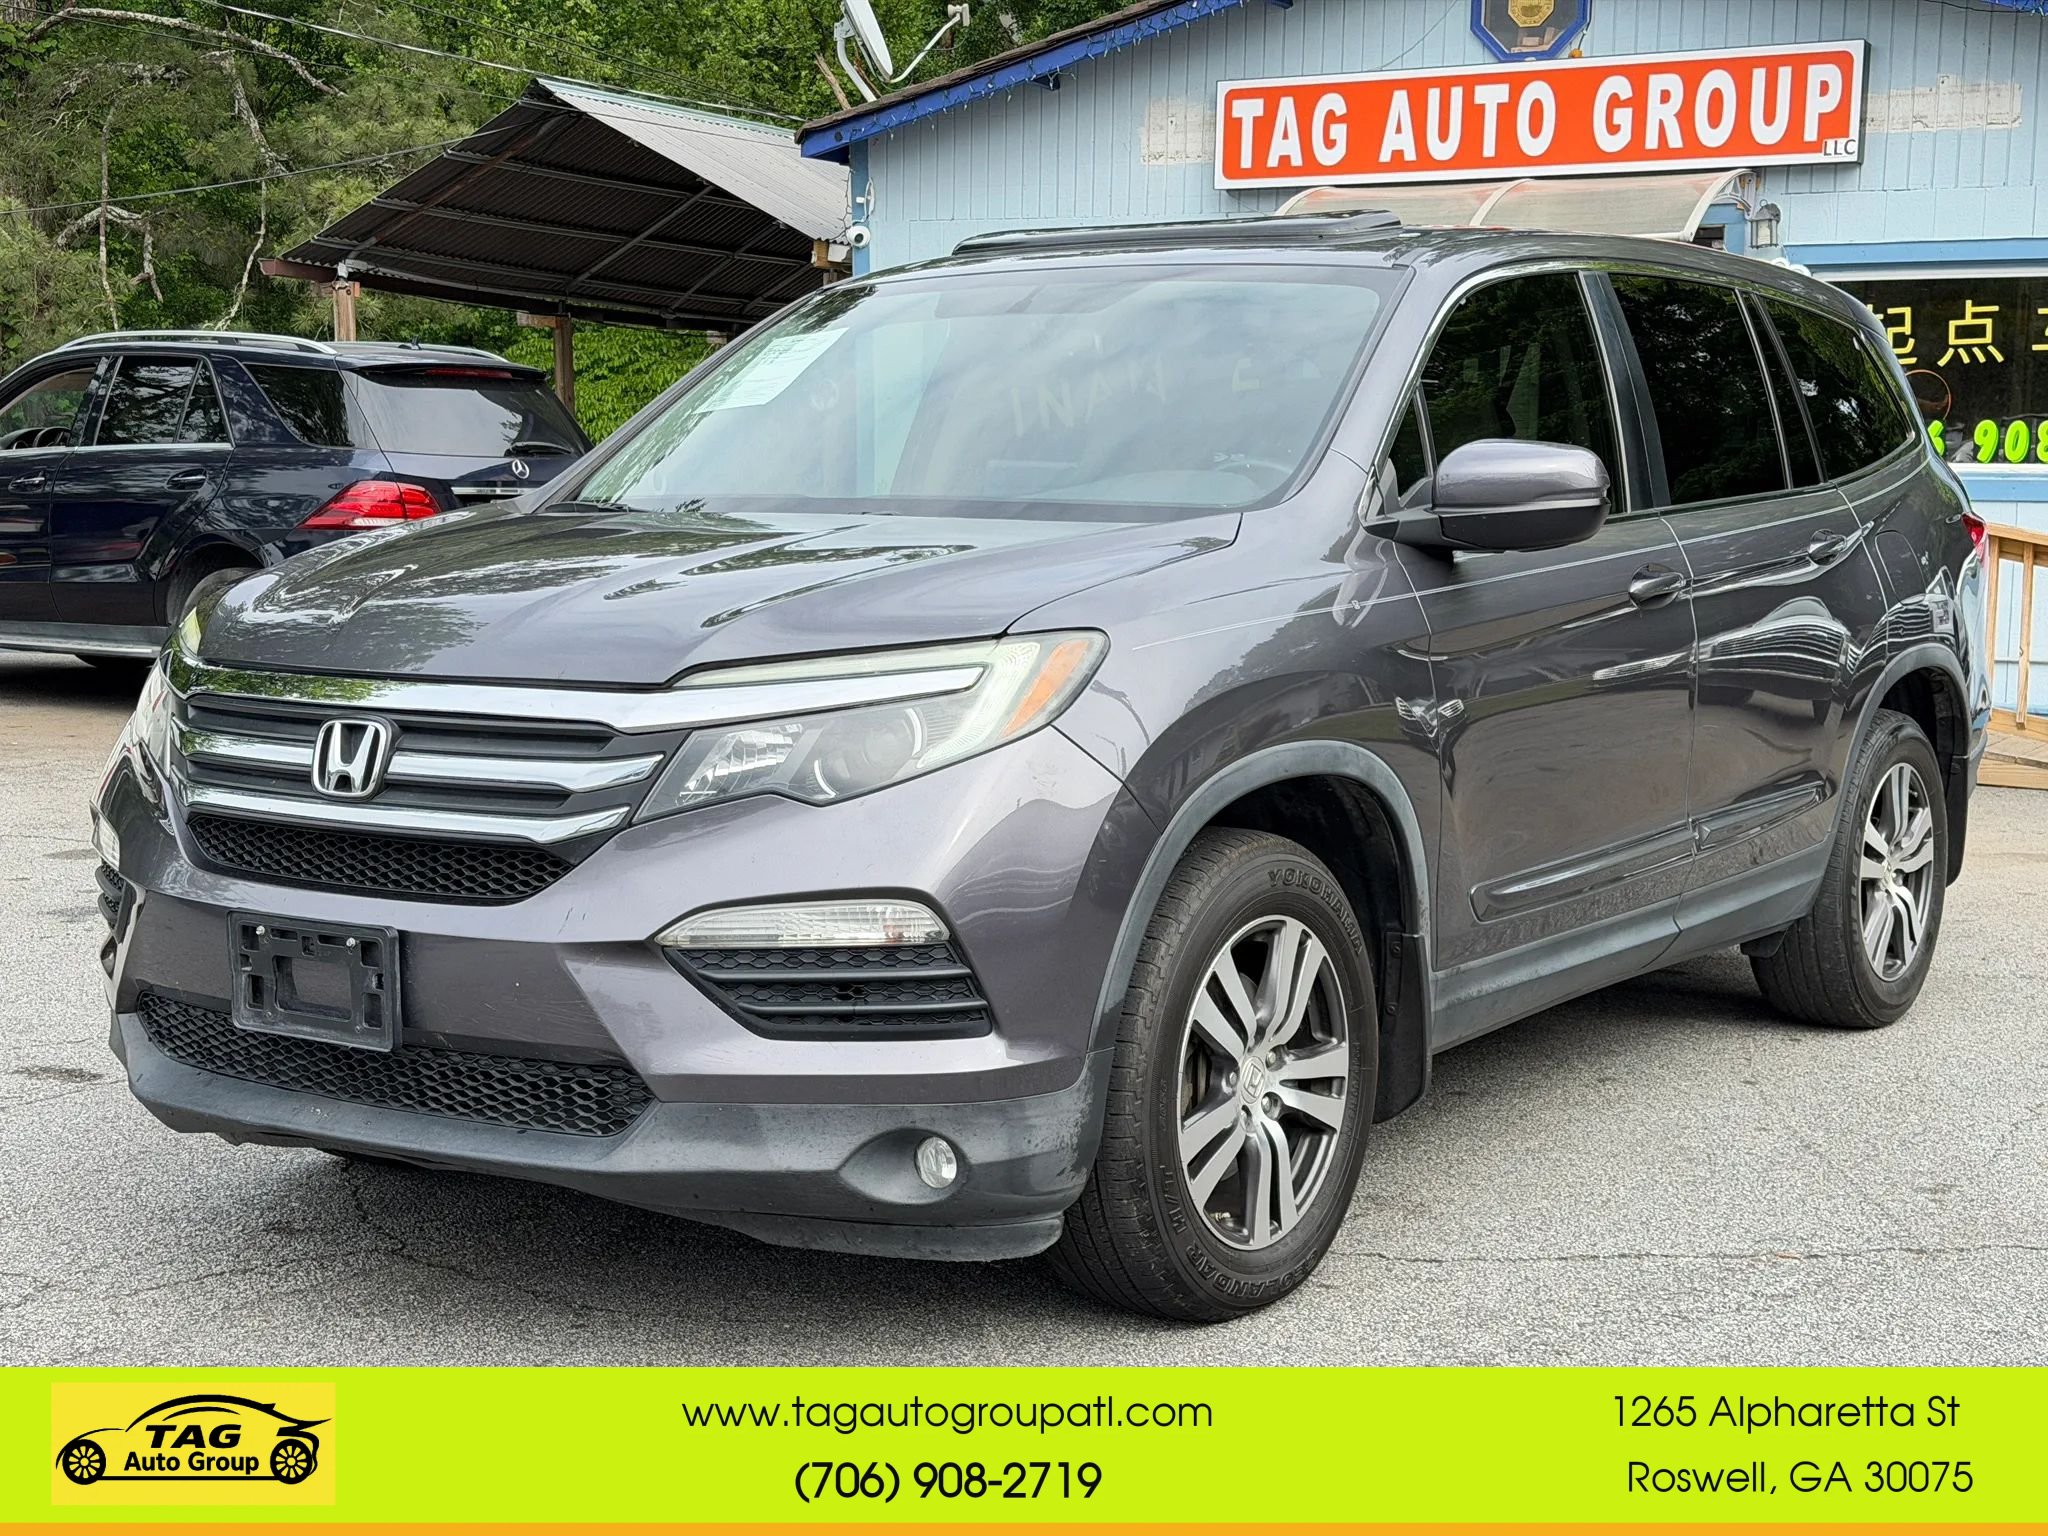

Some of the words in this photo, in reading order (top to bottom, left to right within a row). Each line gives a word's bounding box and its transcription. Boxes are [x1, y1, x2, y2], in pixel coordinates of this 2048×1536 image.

[1232, 92, 1348, 169] TAG
[1378, 80, 1557, 163] AUTO
[1593, 63, 1843, 153] GROUP
[1823, 138, 1857, 157] LLC
[1267, 867, 1363, 958] YOKOHAMA
[1186, 1243, 1318, 1299] GEOLANDAR
